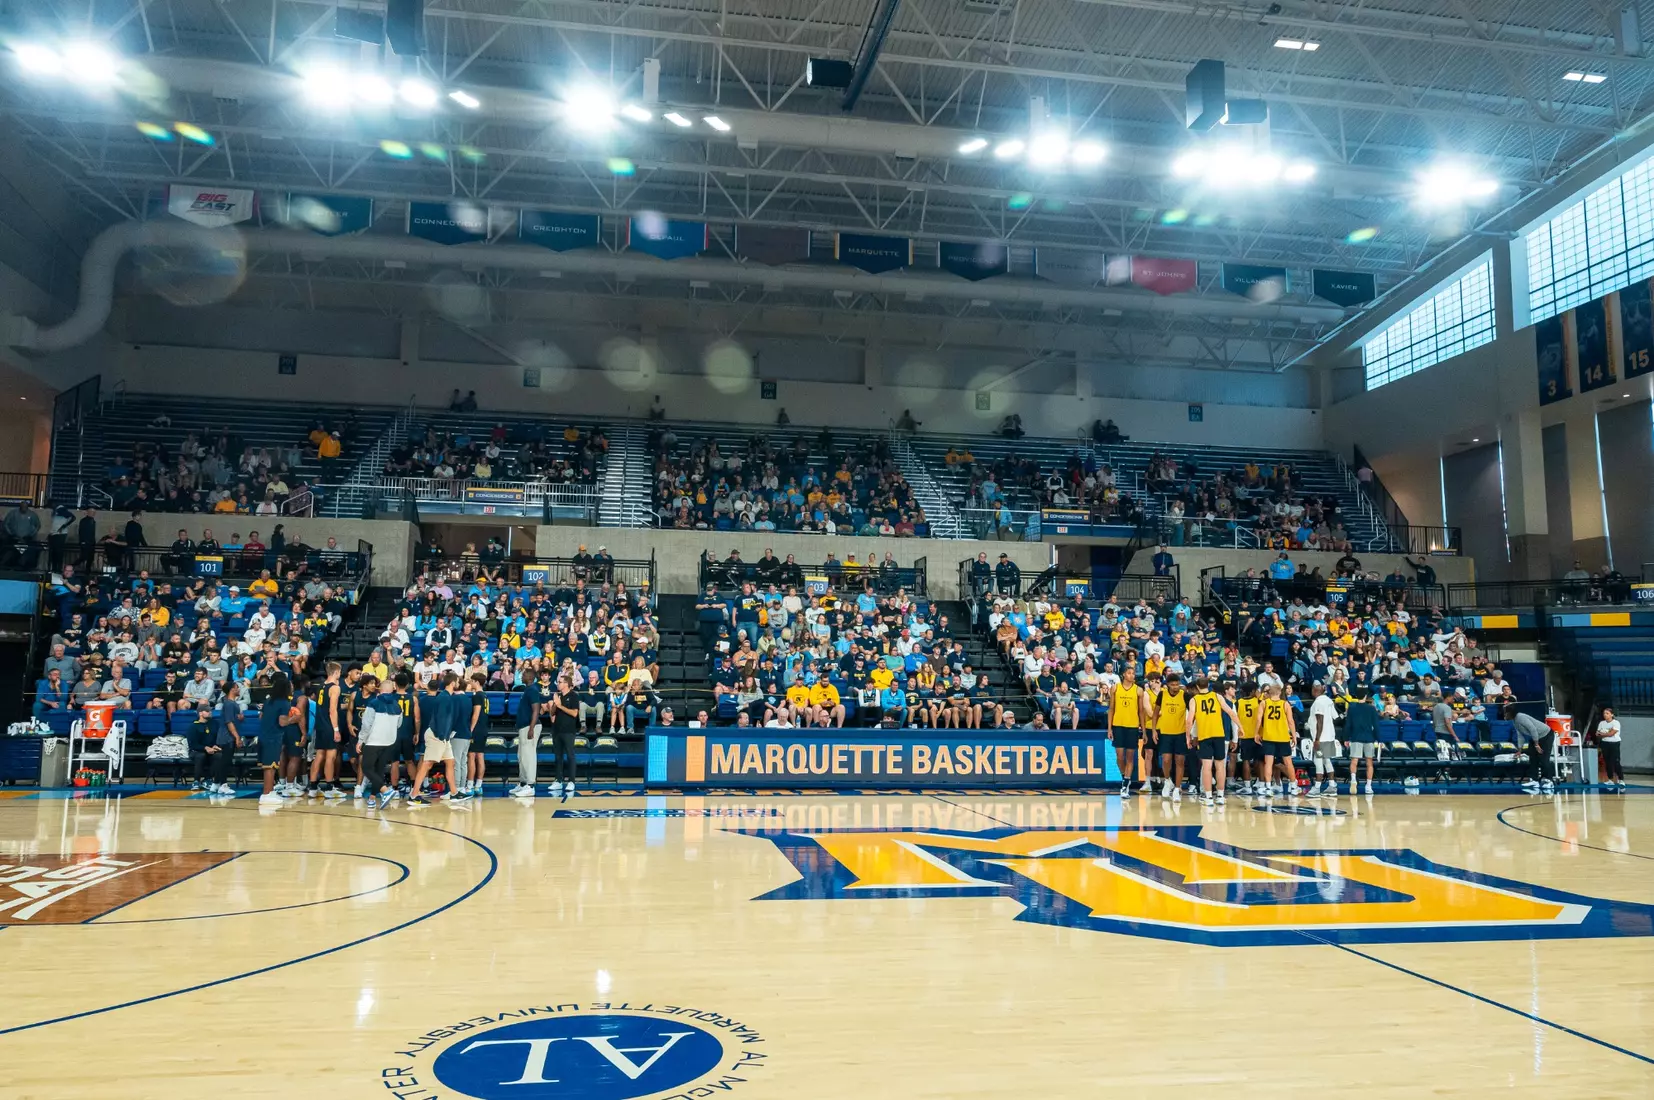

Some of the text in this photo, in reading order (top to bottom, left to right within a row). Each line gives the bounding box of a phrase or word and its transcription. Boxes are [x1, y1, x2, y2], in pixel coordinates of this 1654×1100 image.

[197, 193, 228, 202] BIG
[190, 202, 236, 211] EAST
[532, 225, 586, 234] CREIGHTON
[848, 247, 900, 257] MARQUETTE
[1628, 348, 1650, 370] 15
[1584, 364, 1604, 385] 14
[1547, 380, 1558, 397] 3
[200, 562, 217, 572] 101
[527, 572, 545, 582] 102
[1070, 585, 1085, 595] 104
[1636, 590, 1654, 600] 106
[1330, 593, 1344, 603] 105
[1200, 698, 1216, 715] 42
[1244, 703, 1254, 718] 5
[89, 710, 101, 722] G
[1267, 705, 1282, 720] 25
[1562, 722, 1571, 732] G
[710, 744, 1102, 775] MARQUETTE BASKETBALL
[394, 1002, 766, 1058] MARQUETTE UNIVERSITY
[459, 1031, 696, 1085] AL
